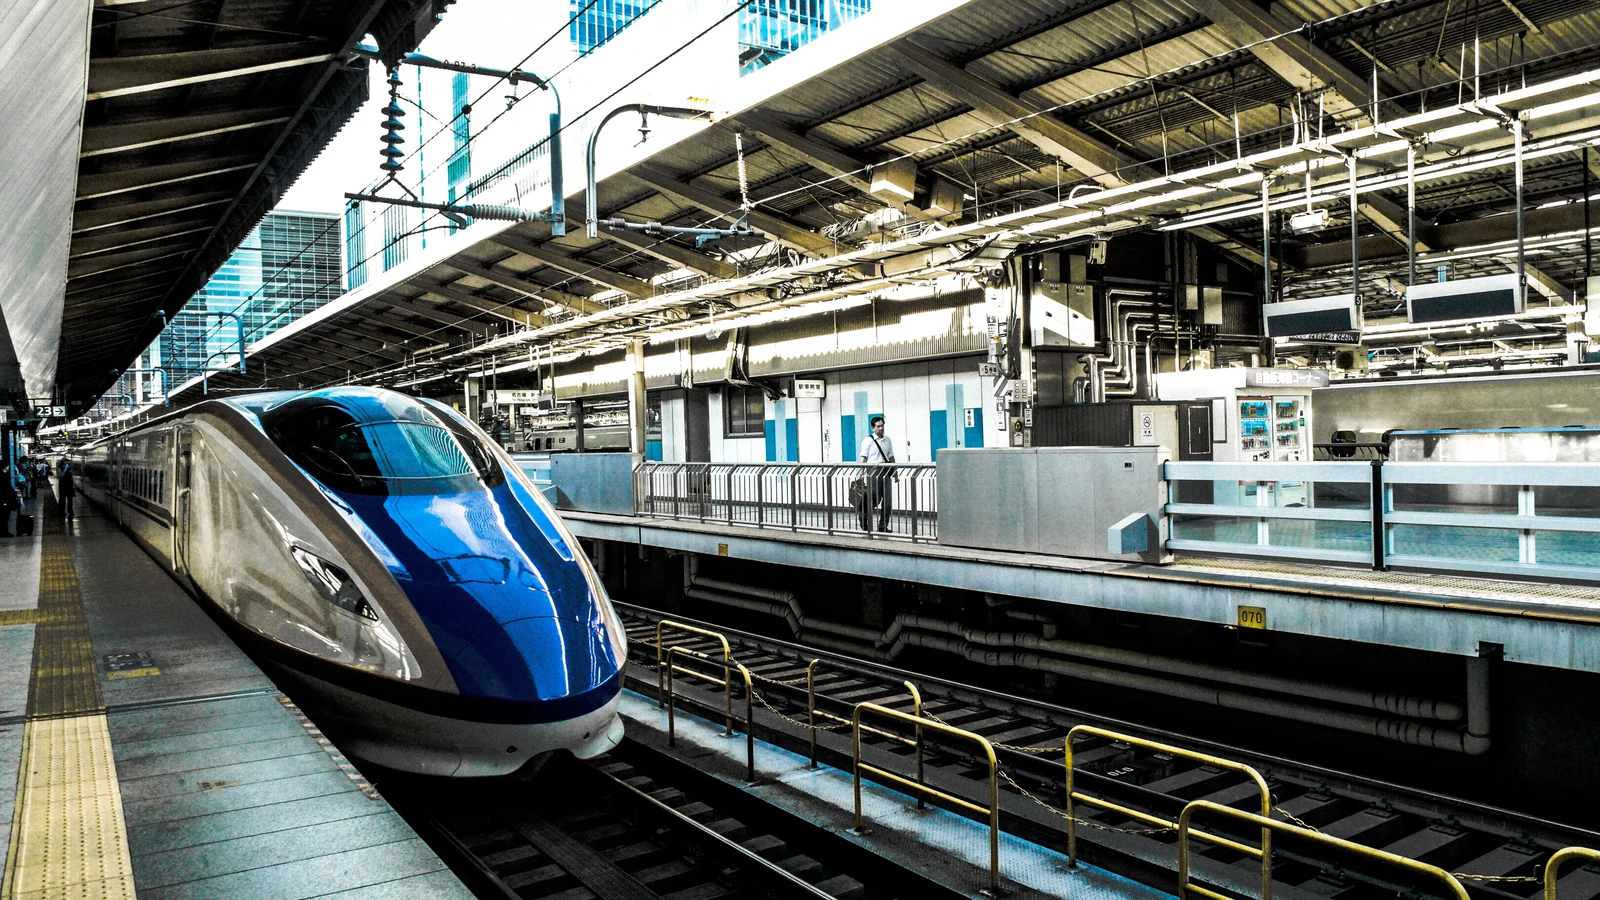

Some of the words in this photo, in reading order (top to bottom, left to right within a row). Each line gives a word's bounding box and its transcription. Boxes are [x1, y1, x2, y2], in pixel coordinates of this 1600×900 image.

[1521, 276, 1526, 285] 4
[1356, 296, 1361, 305] 5
[37, 406, 52, 416] 23
[1241, 610, 1263, 624] 070
